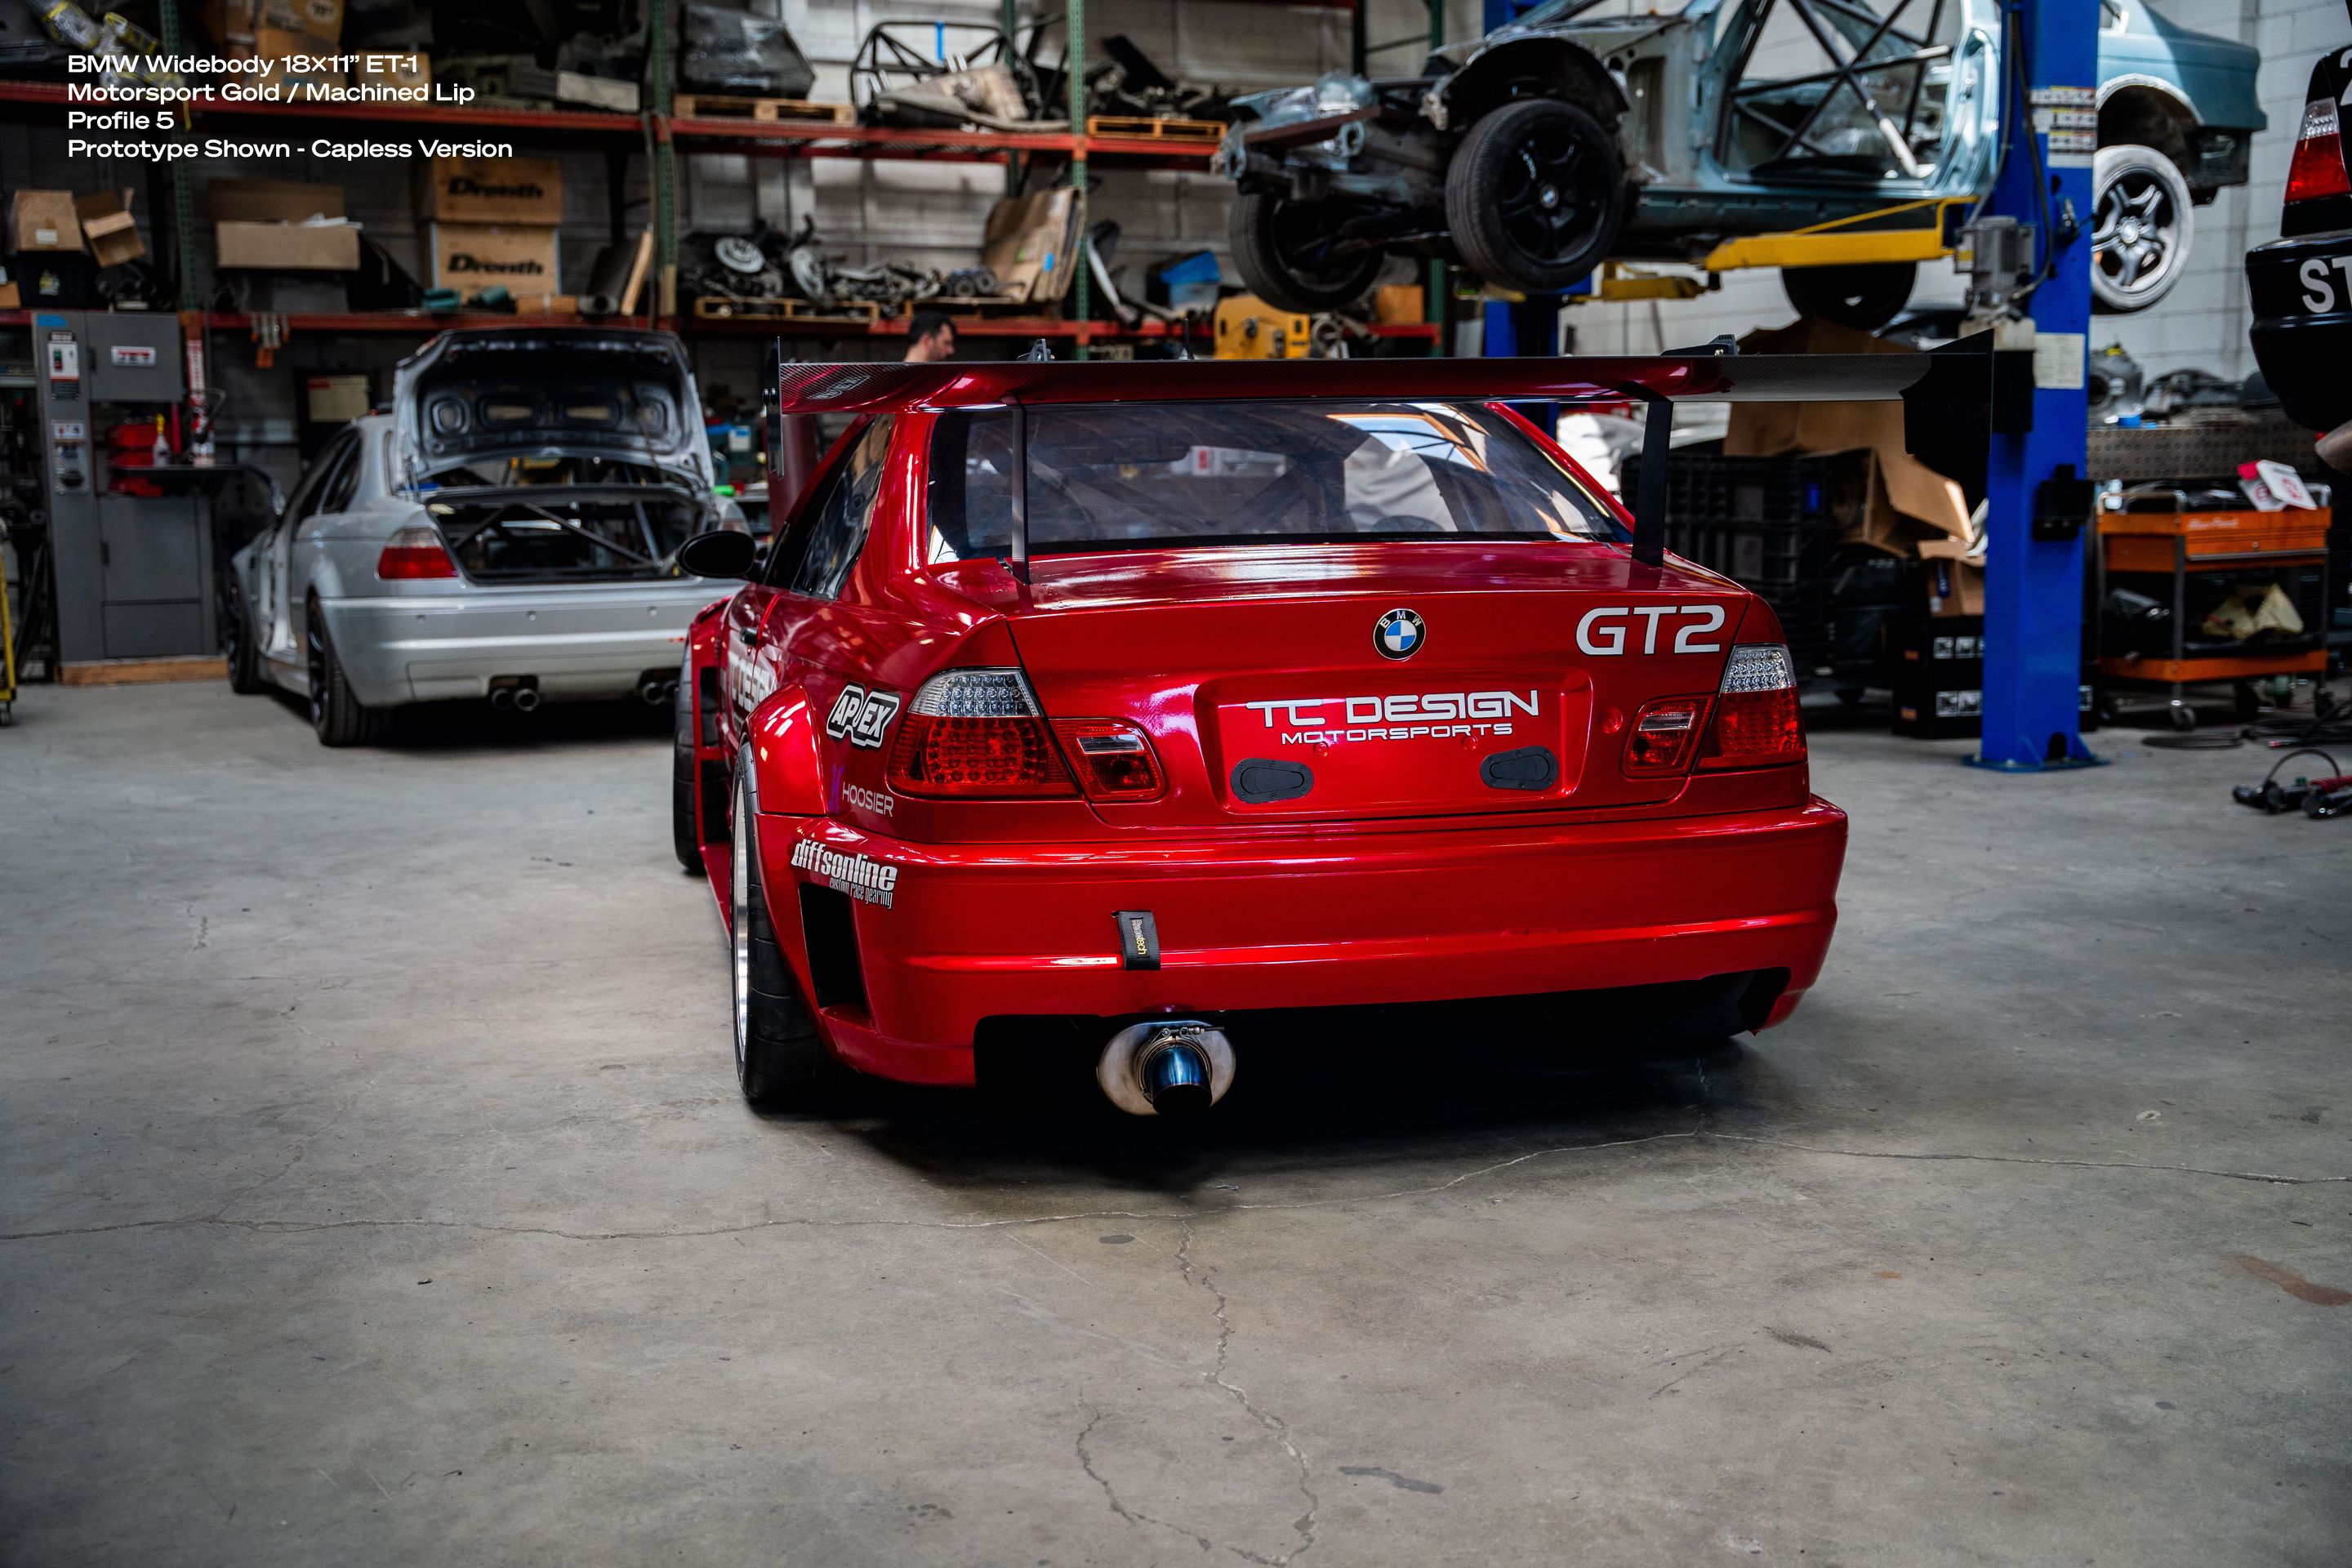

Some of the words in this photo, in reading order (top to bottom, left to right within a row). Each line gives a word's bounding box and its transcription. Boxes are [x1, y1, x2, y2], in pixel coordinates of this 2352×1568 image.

[1379, 610, 1423, 630] BMW
[1575, 604, 1726, 655] GT2
[830, 693, 893, 739] APEX
[1245, 697, 1326, 728] TC
[1345, 690, 1539, 724] DESIGN
[1281, 723, 1513, 745] MOTORSPORTS
[841, 782, 894, 817] HOOSIER
[791, 838, 898, 892] diffsonline
[829, 876, 849, 894] custom
[850, 884, 865, 900] race
[866, 887, 893, 910] gearing
